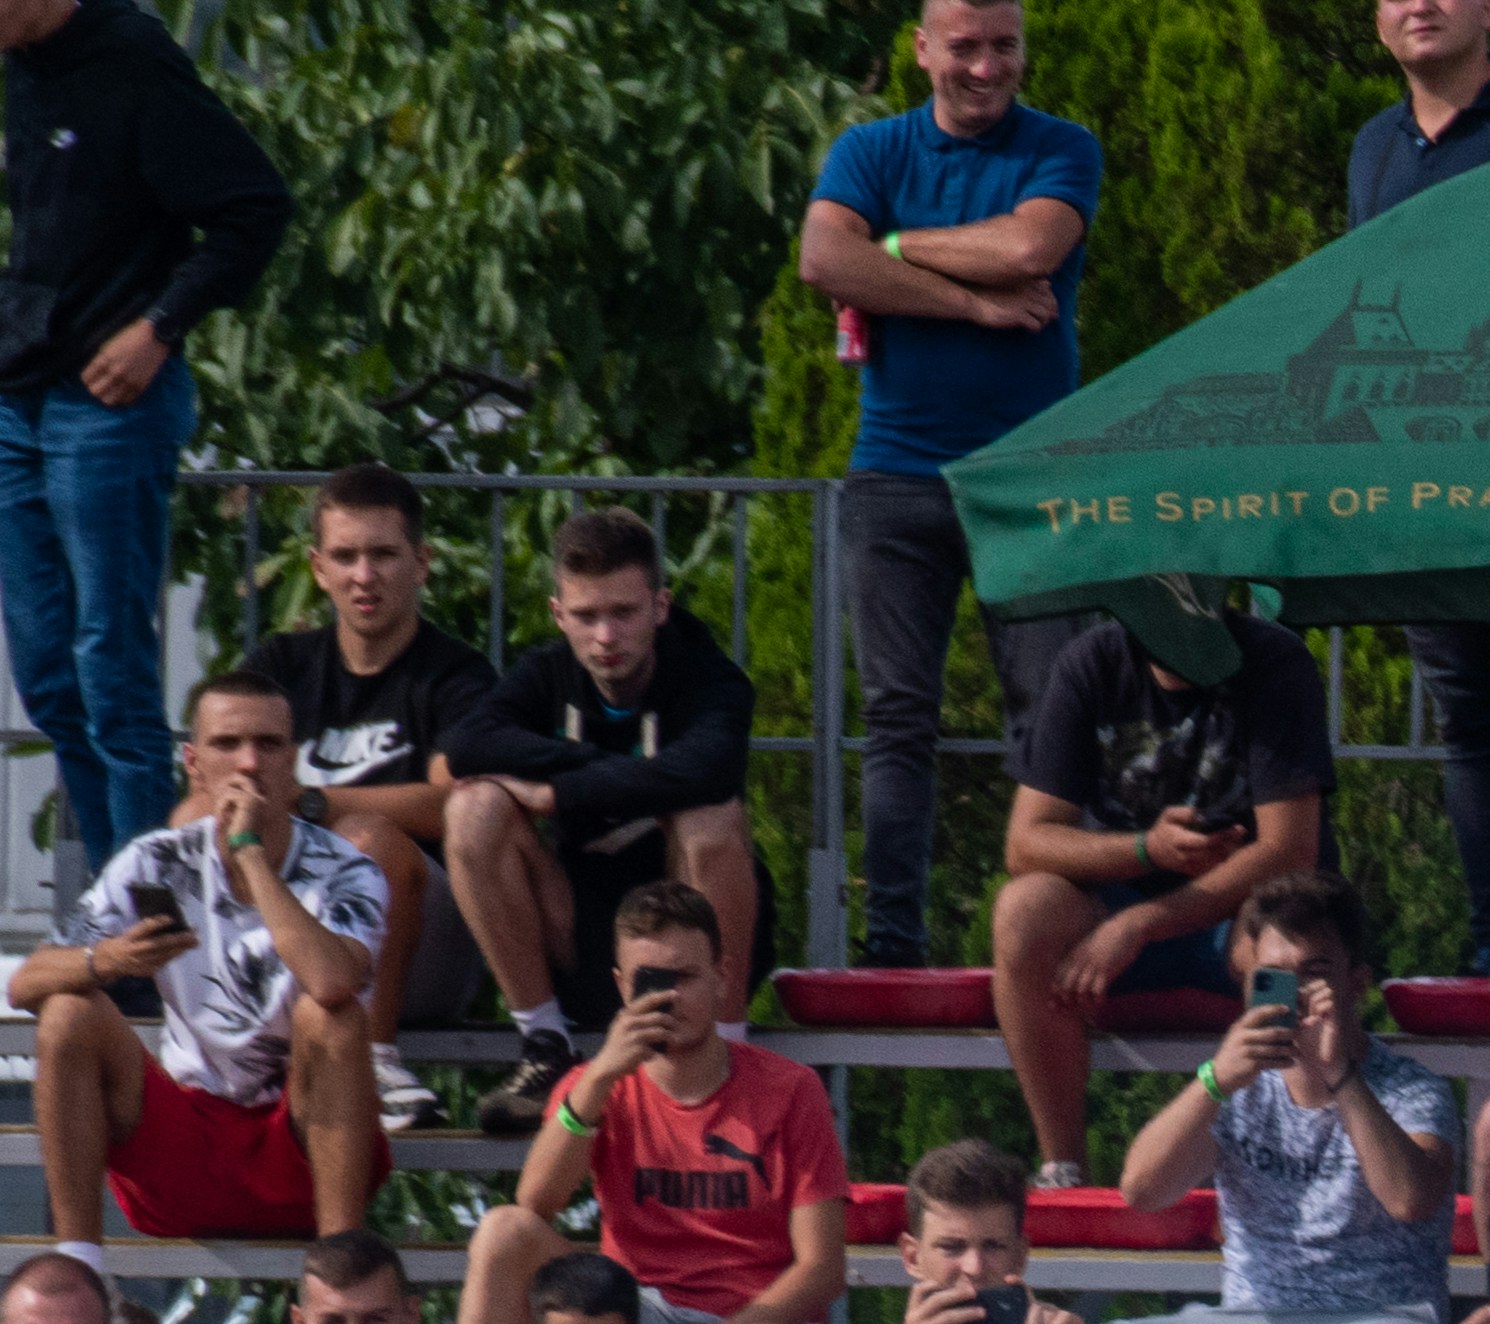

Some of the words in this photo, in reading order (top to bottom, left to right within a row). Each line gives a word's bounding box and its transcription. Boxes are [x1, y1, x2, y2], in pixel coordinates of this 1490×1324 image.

[1036, 497, 1132, 534] THE
[1155, 490, 1310, 523] SPIRIT
[1327, 485, 1391, 518] OF
[635, 1168, 749, 1208] PUMA
